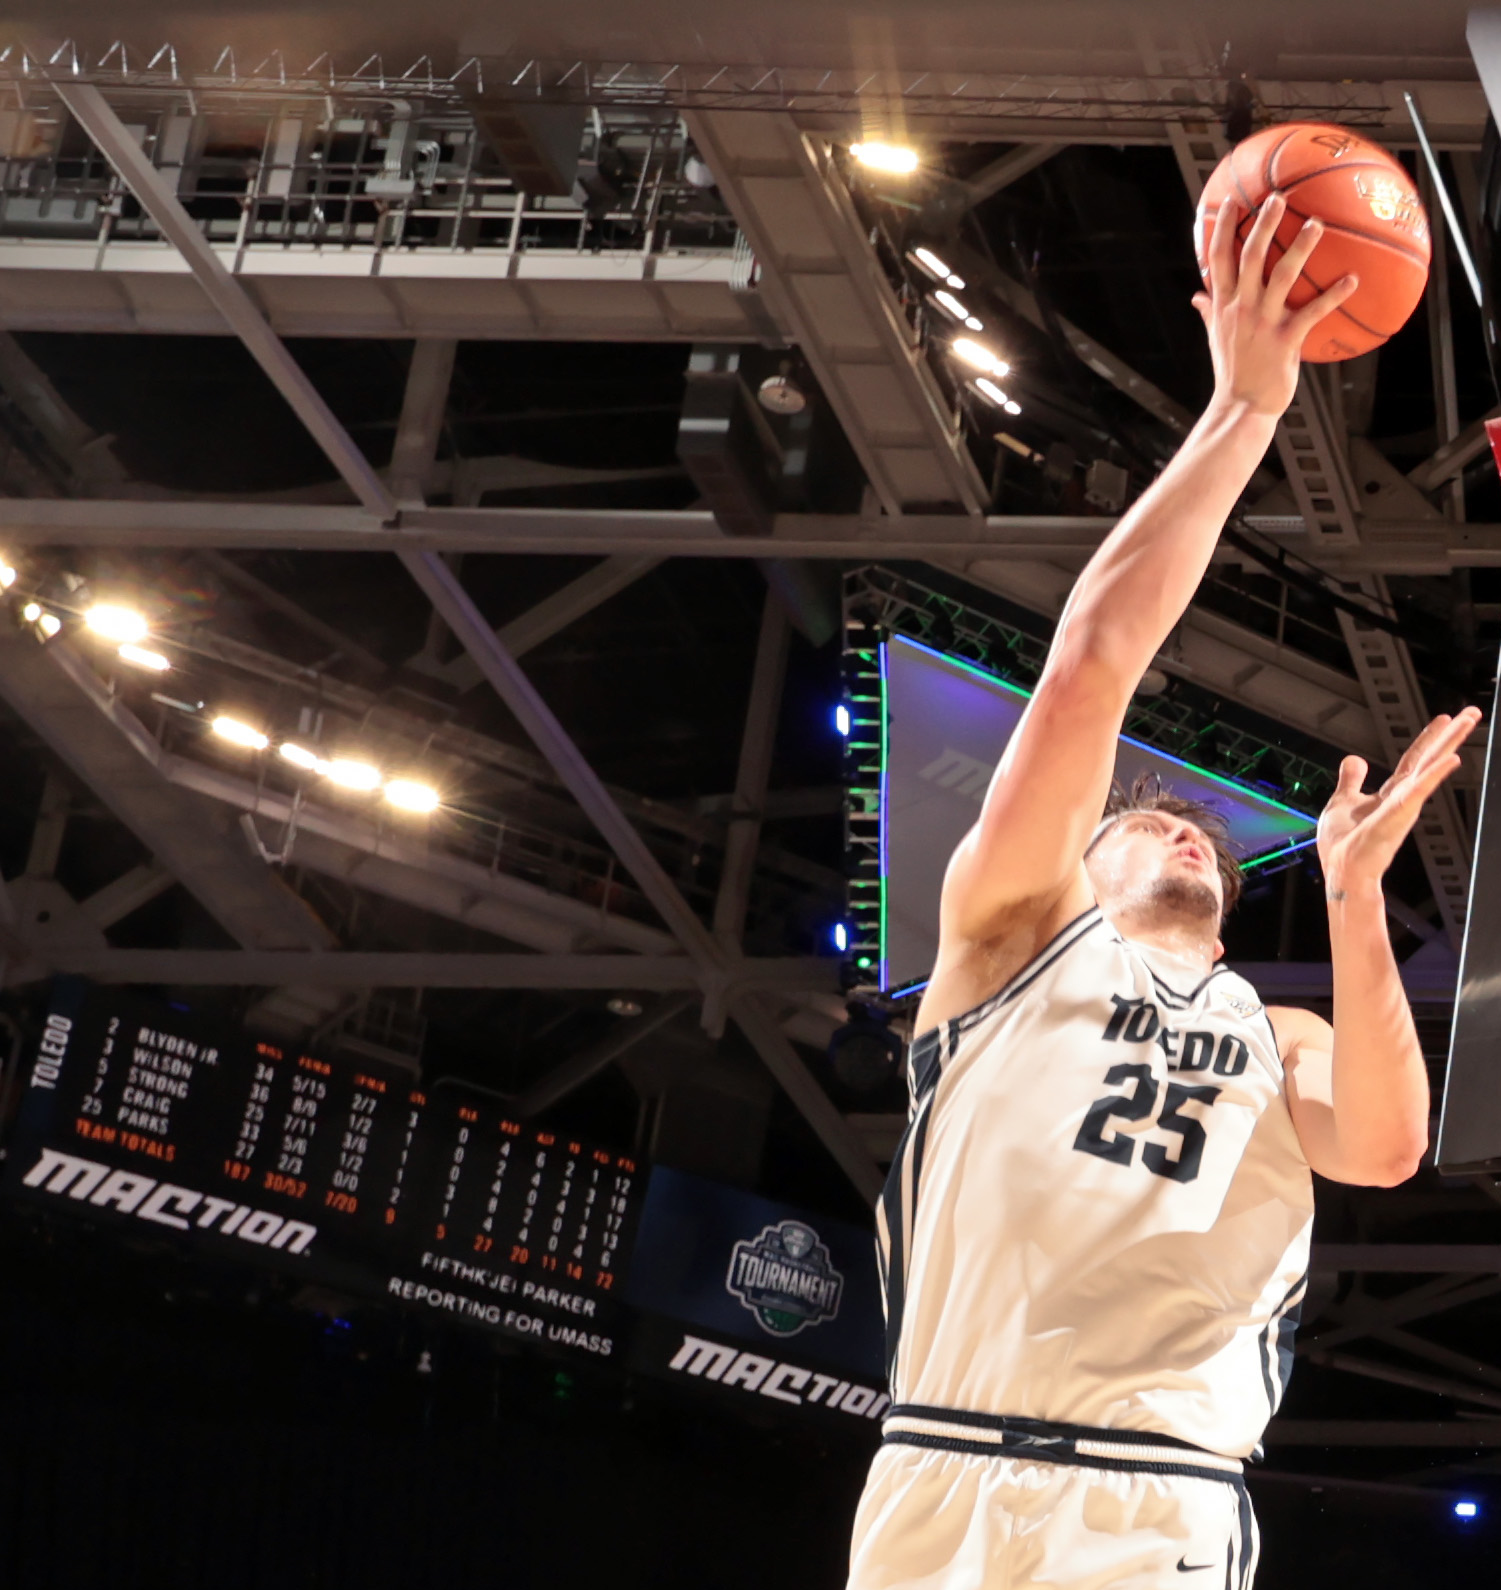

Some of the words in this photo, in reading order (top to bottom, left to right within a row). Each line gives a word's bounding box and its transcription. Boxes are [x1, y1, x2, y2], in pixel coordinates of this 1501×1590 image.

[30, 1013, 72, 1090] TOLEDO
[1101, 992, 1250, 1077] TOEDO
[128, 1066, 189, 1099] STRONG
[133, 1047, 193, 1079] WILSON
[117, 1105, 169, 1136] PARKS
[122, 1085, 171, 1115] CRAIG
[75, 1117, 116, 1144] TEAM
[120, 1130, 176, 1162] TOTALS
[1052, 1063, 1223, 1185] 25
[521, 1281, 597, 1318] PARKER
[737, 1252, 839, 1311] TOURNAMENT
[388, 1276, 501, 1325] REPORTING
[503, 1310, 546, 1337] FOR
[548, 1324, 614, 1357] UMASS
